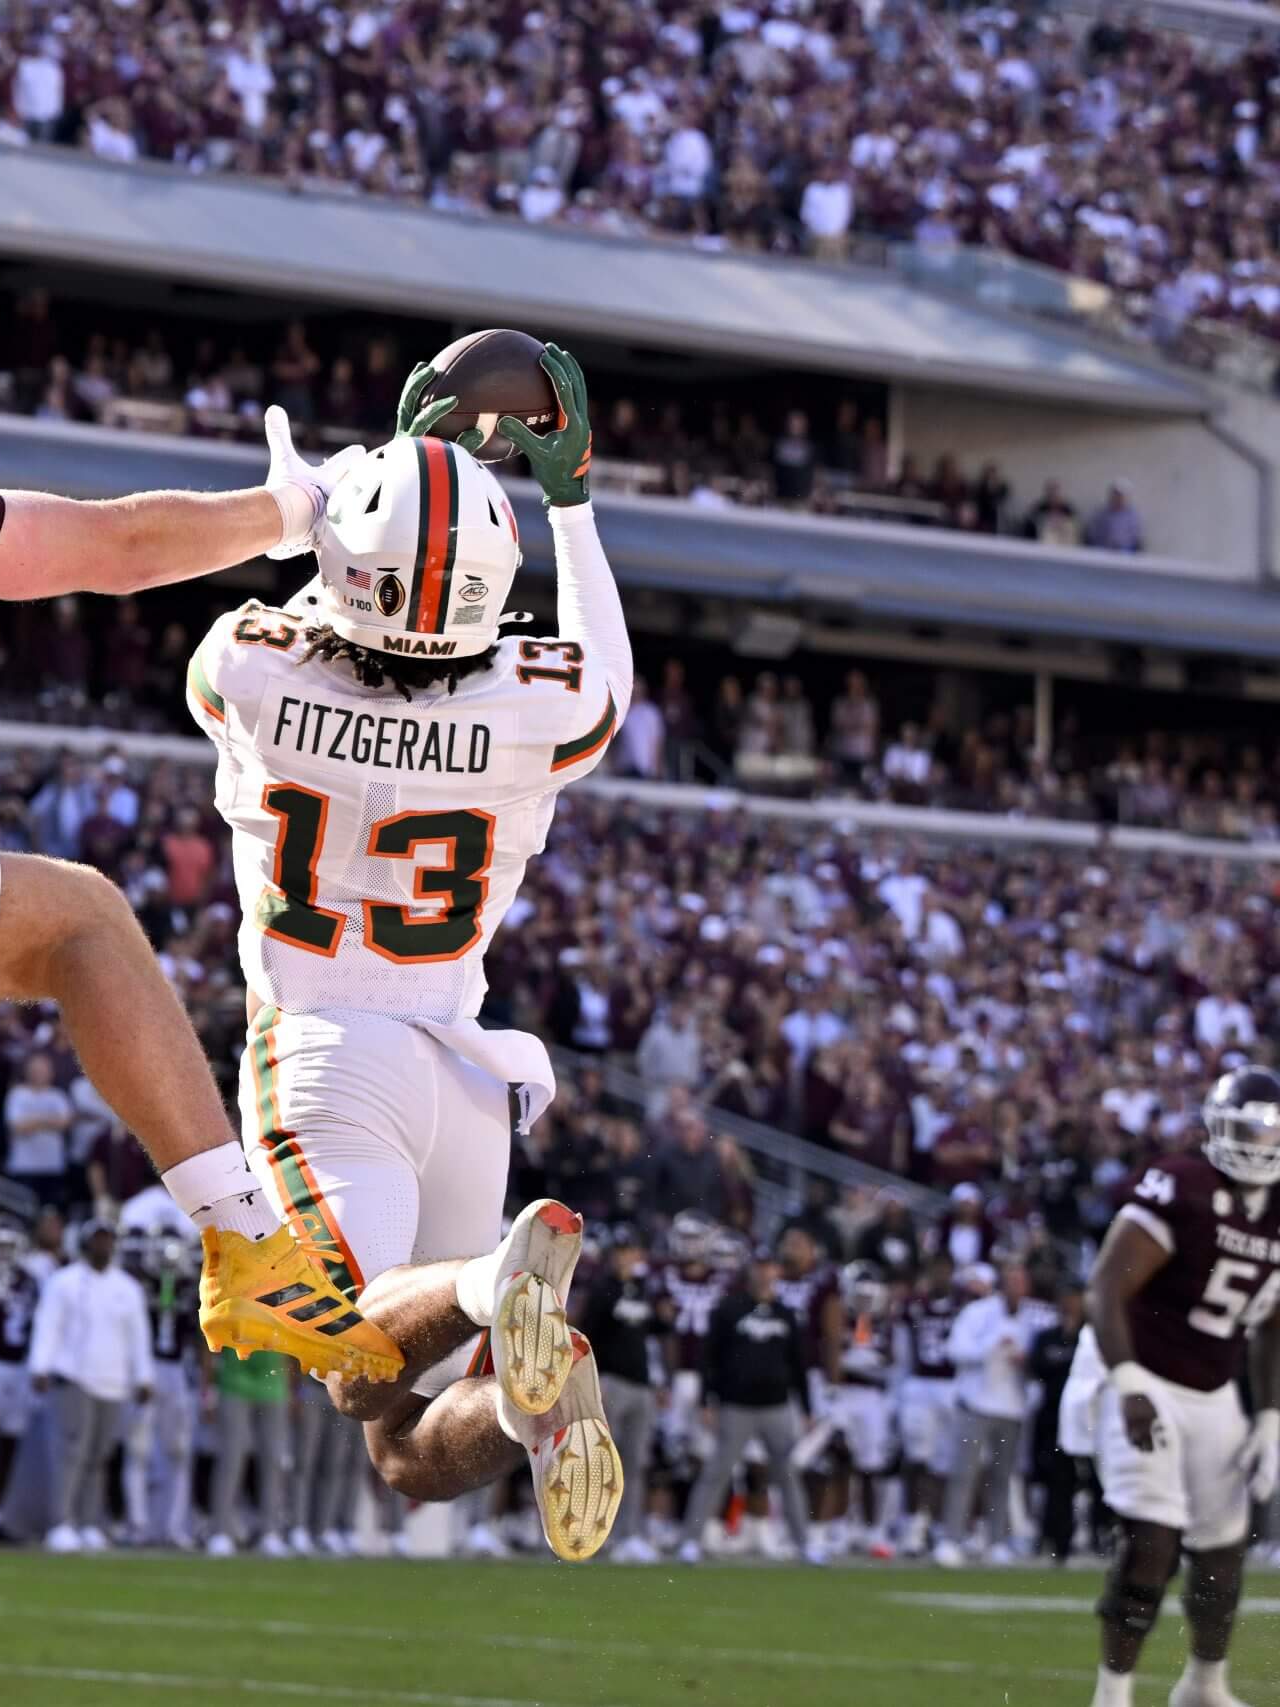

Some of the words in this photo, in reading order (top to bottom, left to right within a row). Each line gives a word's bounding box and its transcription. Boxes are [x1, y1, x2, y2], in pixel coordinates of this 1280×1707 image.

[355, 599, 372, 612] 100
[383, 635, 458, 656] MIAMI
[516, 640, 584, 693] 13
[272, 696, 491, 773] FITZGERALD
[255, 781, 496, 965] 13
